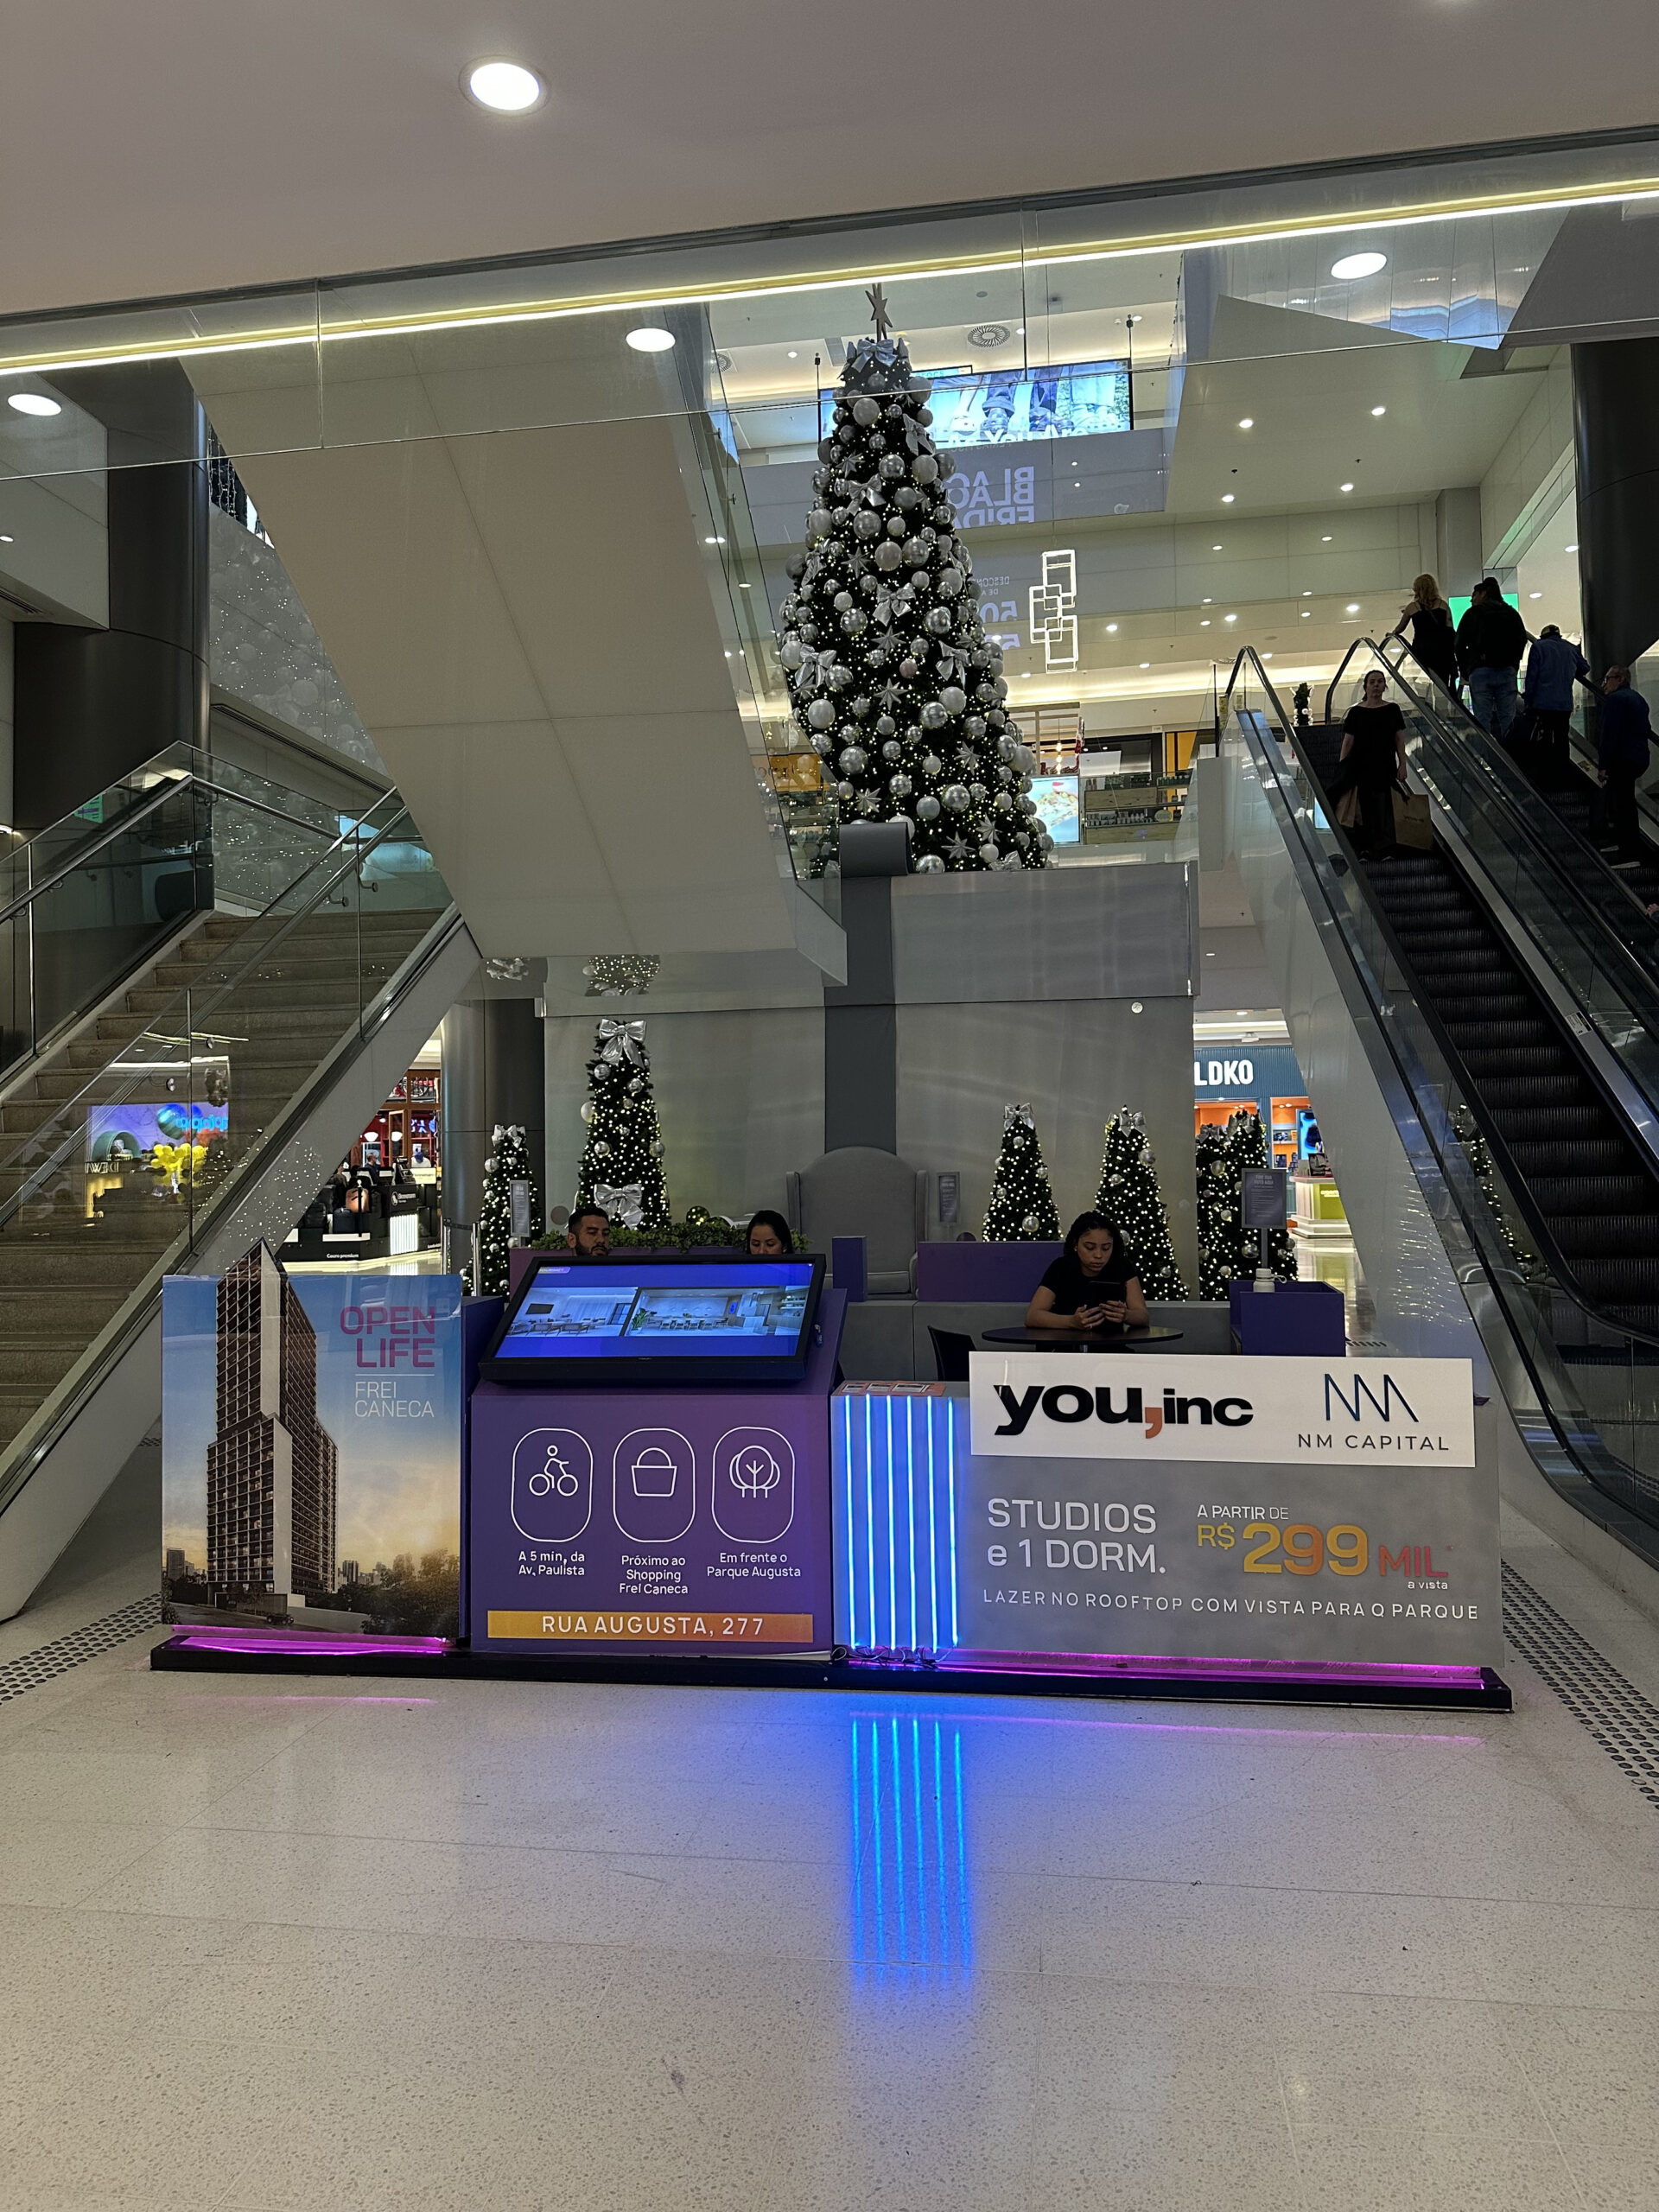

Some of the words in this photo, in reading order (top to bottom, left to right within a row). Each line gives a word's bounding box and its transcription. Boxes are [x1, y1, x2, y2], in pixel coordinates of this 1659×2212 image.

[340, 1306, 435, 1335] OPEN
[356, 1338, 435, 1368] LIFE
[355, 1381, 397, 1399] FREI
[354, 1400, 435, 1418] CANECA
[994, 1384, 1254, 1439] you,inc
[1298, 1433, 1333, 1449] NM
[1344, 1434, 1450, 1452] CAPITAL
[988, 1497, 1157, 1534] STUDIOS
[1197, 1504, 1208, 1518] A
[1211, 1505, 1266, 1520] PARTIR
[1269, 1507, 1289, 1520] DE
[518, 1550, 527, 1561] A
[530, 1550, 537, 1561] 5
[570, 1550, 585, 1562] da
[720, 1552, 738, 1563] Em
[740, 1552, 778, 1563] frente
[779, 1554, 788, 1563] o
[988, 1544, 1007, 1567] e
[1018, 1538, 1032, 1567] 1
[1046, 1539, 1166, 1574] DORM.
[1198, 1522, 1236, 1550] R$
[1243, 1522, 1368, 1576] 299
[621, 1554, 670, 1566] Próximo
[671, 1557, 686, 1566] ao
[538, 1564, 585, 1576] Paulista
[626, 1569, 682, 1583] Shopping
[707, 1566, 750, 1580] Parque
[751, 1566, 802, 1580] Augusta
[643, 1583, 689, 1595] Caneca
[983, 1589, 1046, 1605] LAZER
[1052, 1592, 1079, 1606] NO
[1085, 1593, 1183, 1611] ROOFTOP
[1191, 1598, 1238, 1613] COM
[1244, 1599, 1306, 1615] VISTA
[1311, 1600, 1366, 1617] PARA
[1392, 1603, 1478, 1620] PARQUE
[542, 1615, 588, 1634] RUA
[594, 1616, 715, 1637] AUGUSTA,
[722, 1617, 764, 1636] 277
